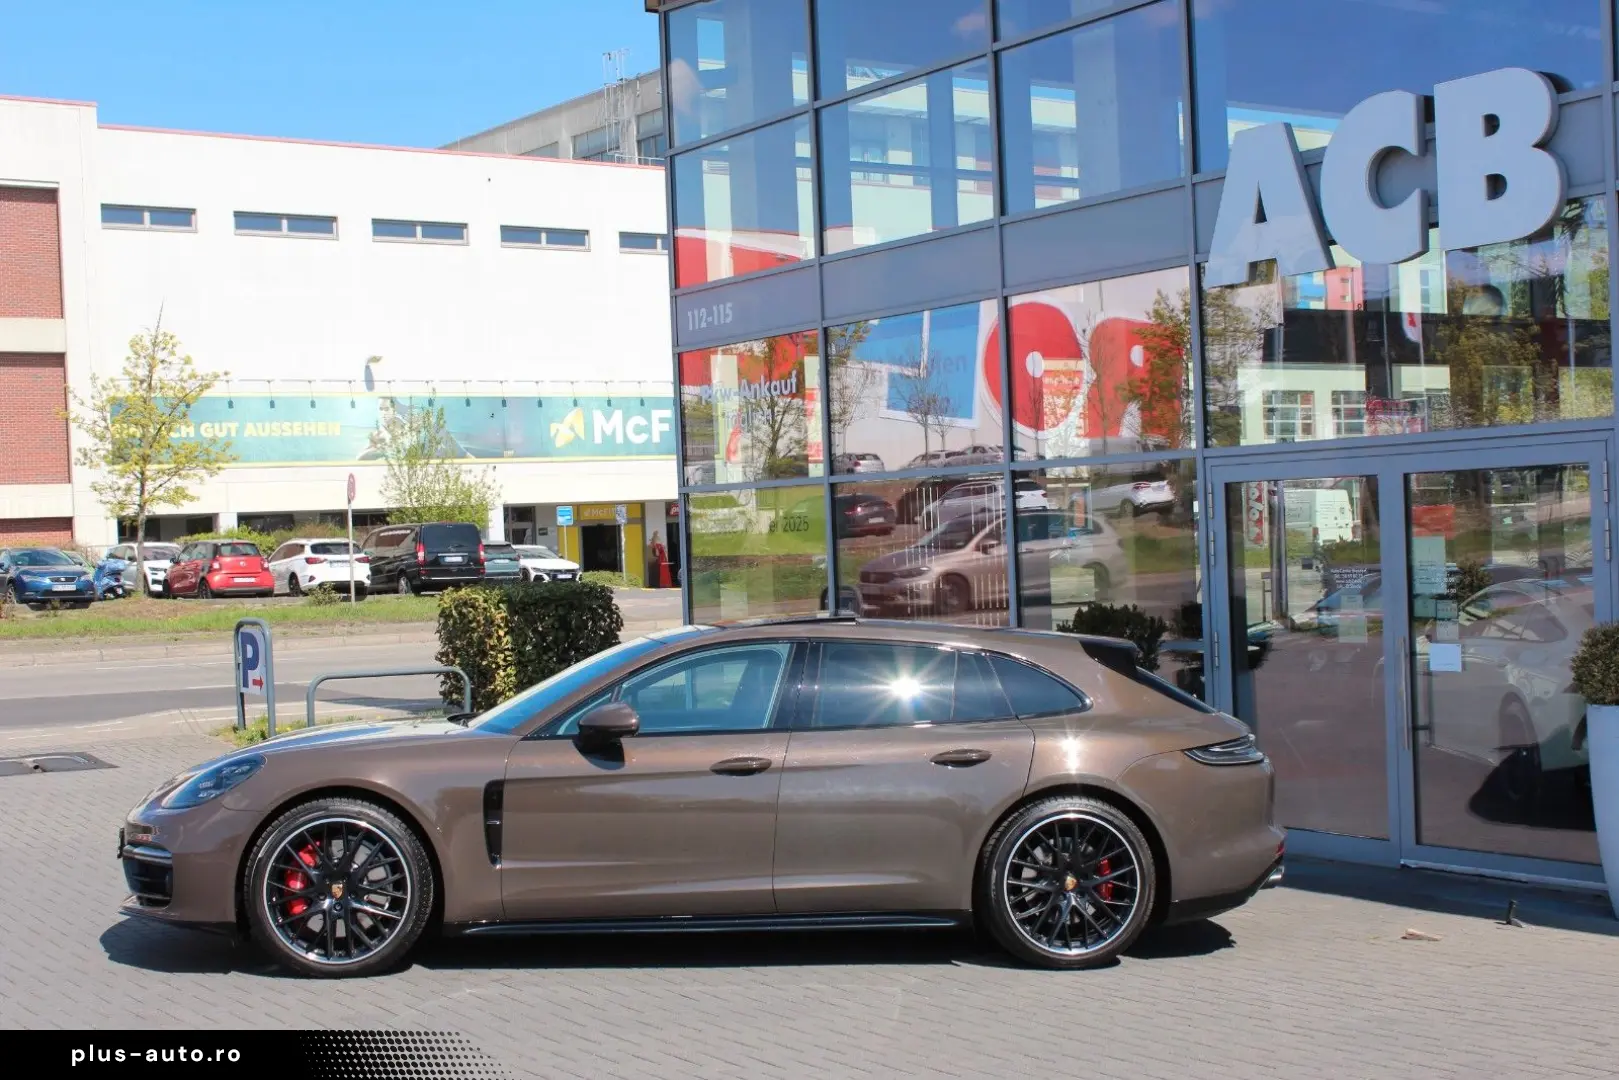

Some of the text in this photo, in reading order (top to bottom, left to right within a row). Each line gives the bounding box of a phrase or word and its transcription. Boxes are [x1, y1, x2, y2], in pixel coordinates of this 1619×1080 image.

[1204, 67, 1566, 288] ACB
[687, 302, 733, 331] 112-115
[200, 421, 239, 438] GUT
[243, 421, 341, 437] AUSSEHEN
[782, 516, 810, 532] 2025
[240, 631, 260, 689] P
